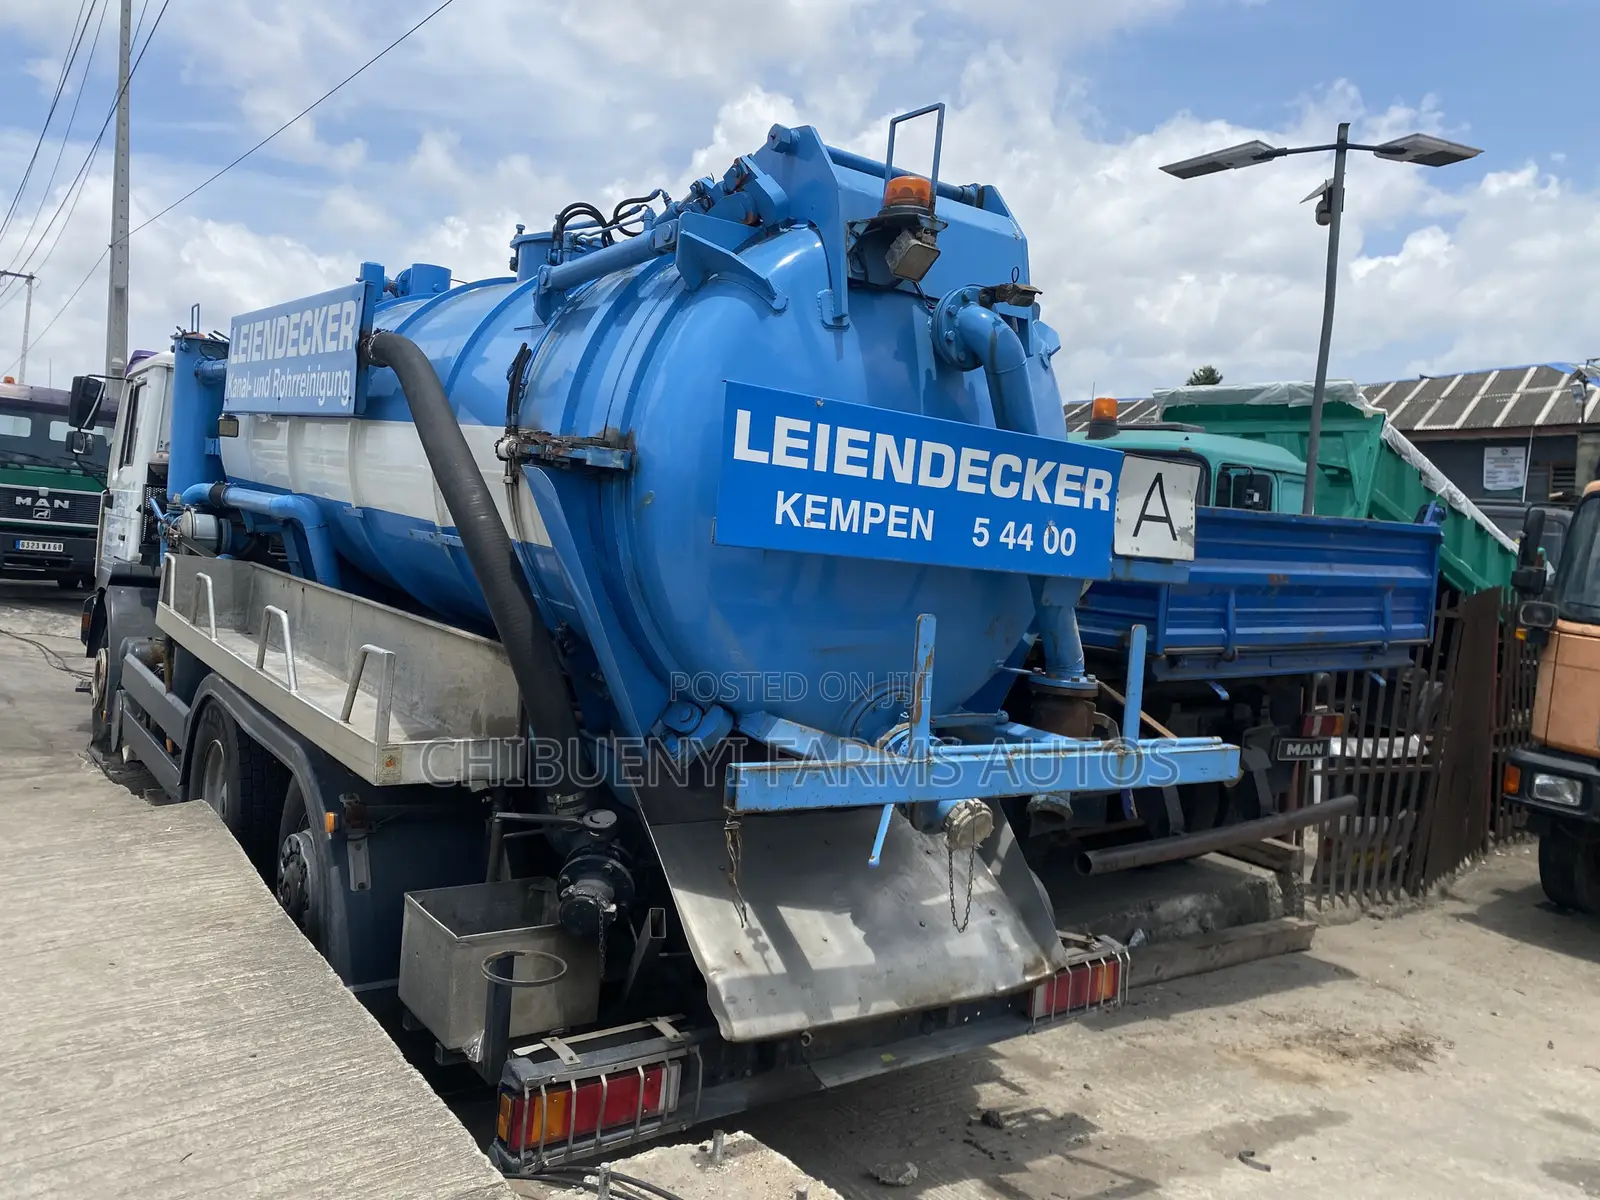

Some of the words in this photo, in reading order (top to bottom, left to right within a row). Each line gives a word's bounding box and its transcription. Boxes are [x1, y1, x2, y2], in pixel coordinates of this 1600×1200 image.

[230, 300, 357, 365] LEIENDECKER
[227, 370, 252, 399] Kanal-
[253, 368, 272, 398] und
[272, 364, 351, 407] Rohrreinigung
[733, 408, 1114, 512] LEIENDECKER
[15, 496, 70, 509] MAN
[775, 490, 935, 542] KEMPEN
[972, 517, 990, 547] 5
[1000, 521, 1034, 551] 44
[1043, 524, 1077, 557] 00
[1132, 472, 1178, 541] A
[1286, 743, 1324, 756] MAN
